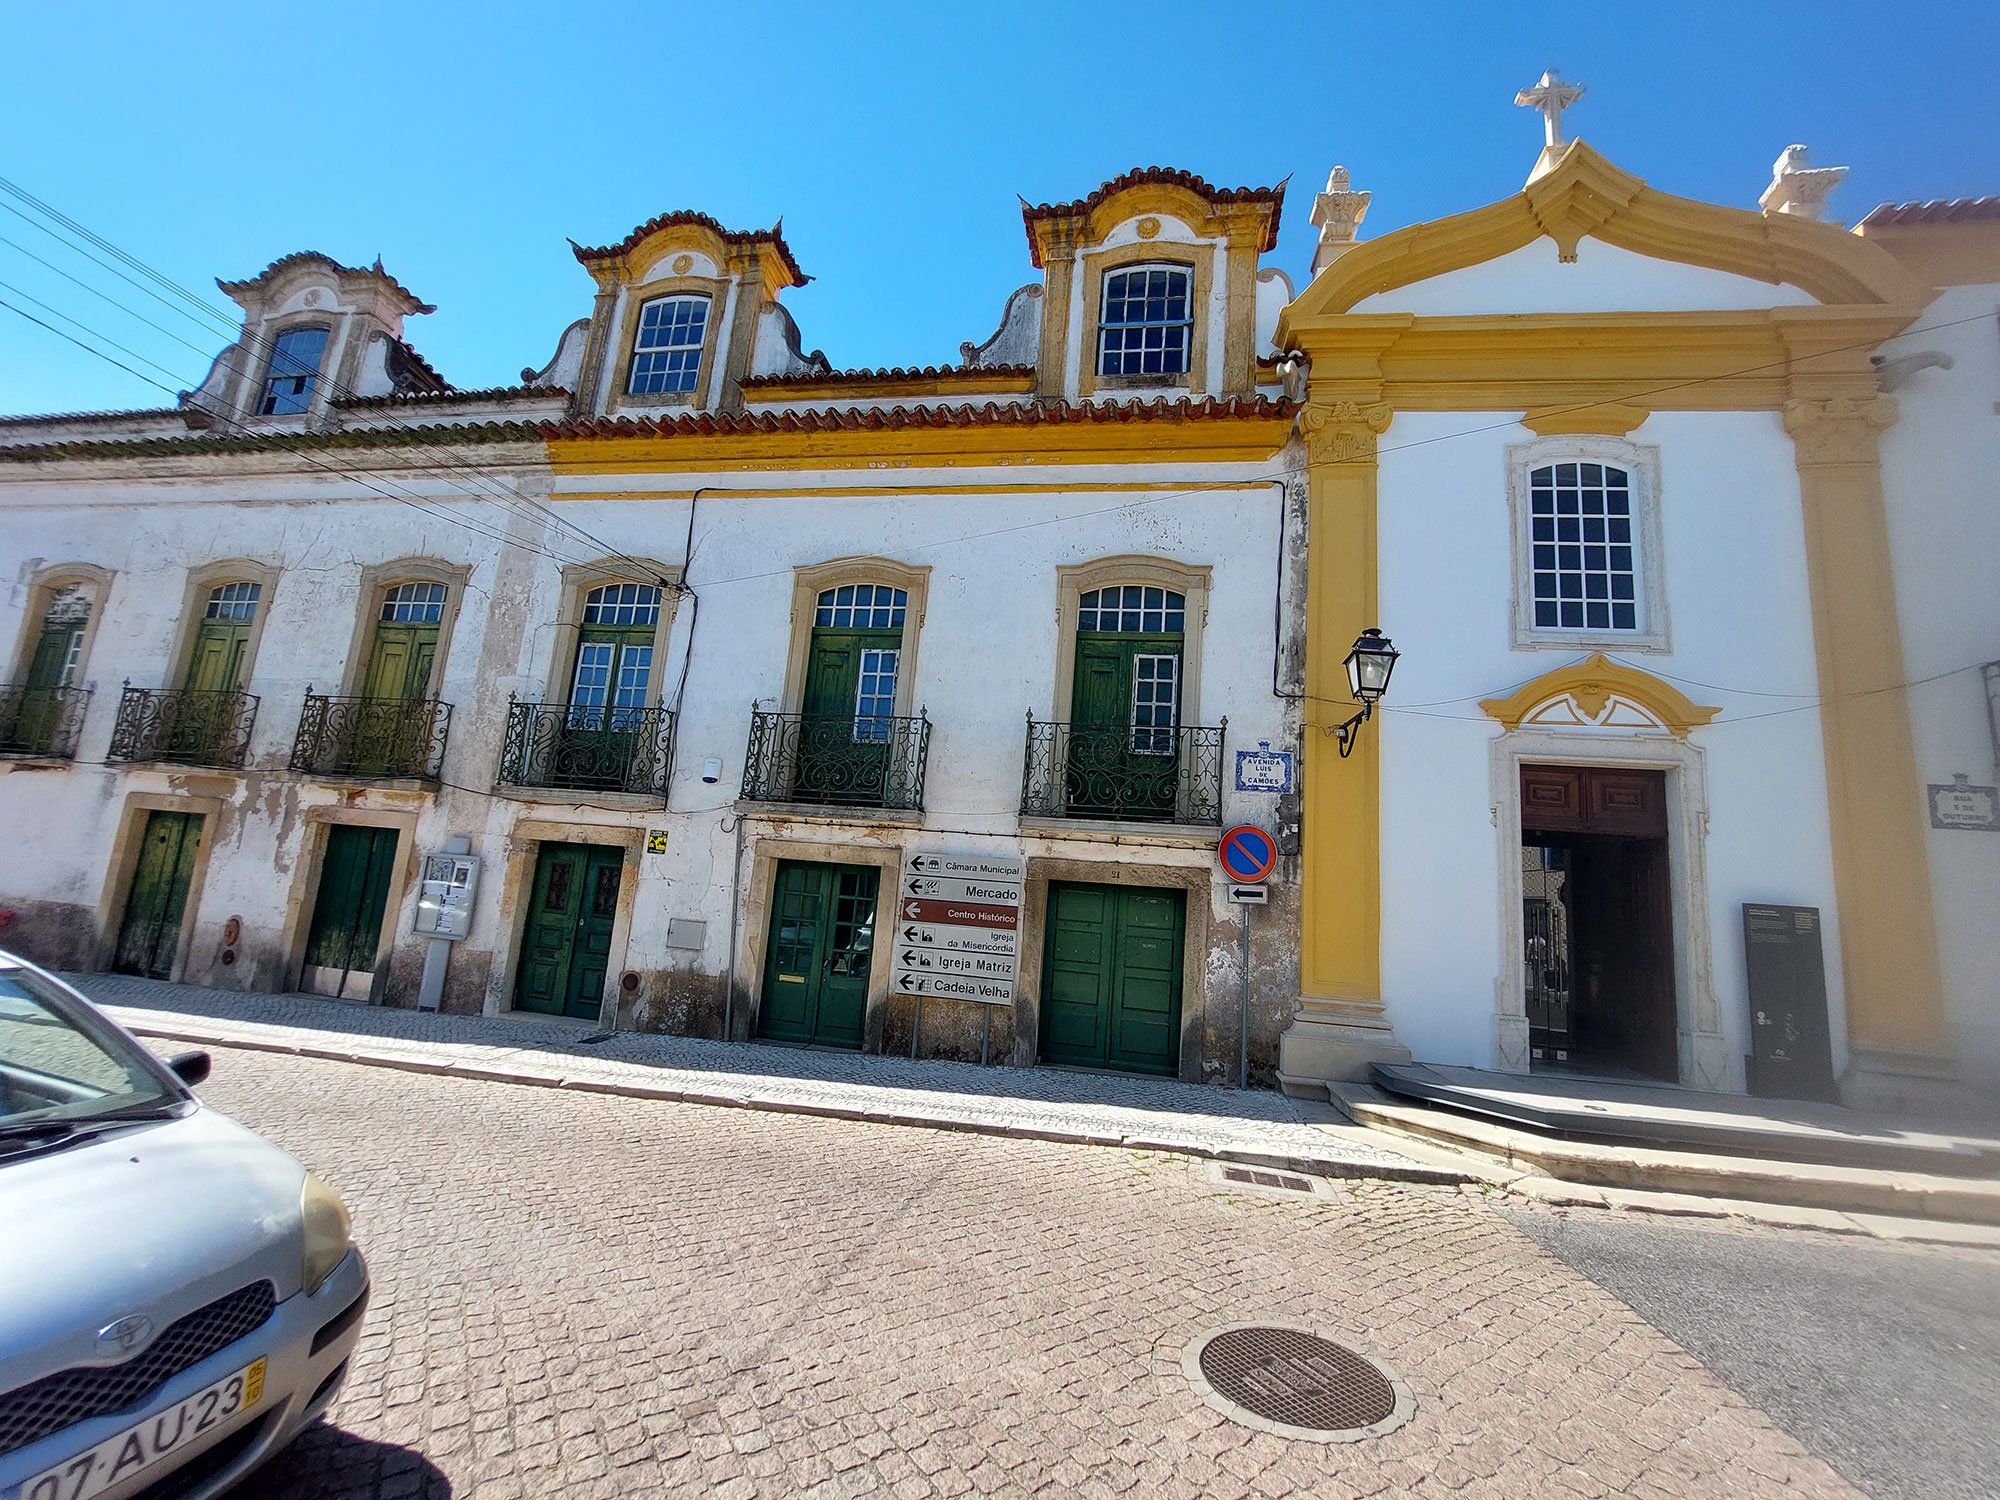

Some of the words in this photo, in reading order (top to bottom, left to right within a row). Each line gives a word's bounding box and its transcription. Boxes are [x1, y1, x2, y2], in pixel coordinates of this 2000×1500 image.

[1247, 777, 1279, 785] CAMÕES
[945, 861, 978, 872] Câmara
[979, 864, 1020, 876] Municipal
[965, 885, 1018, 900] Mercado
[947, 909, 976, 920] Centro
[978, 911, 1016, 922] Histórico
[990, 932, 1014, 942] Igreja
[947, 939, 958, 948] da
[962, 940, 1014, 953] Misericórdia
[939, 955, 971, 971] Igreja
[976, 959, 1012, 974] Matriz
[934, 979, 975, 995] Cadeia
[979, 984, 1010, 999] Velha
